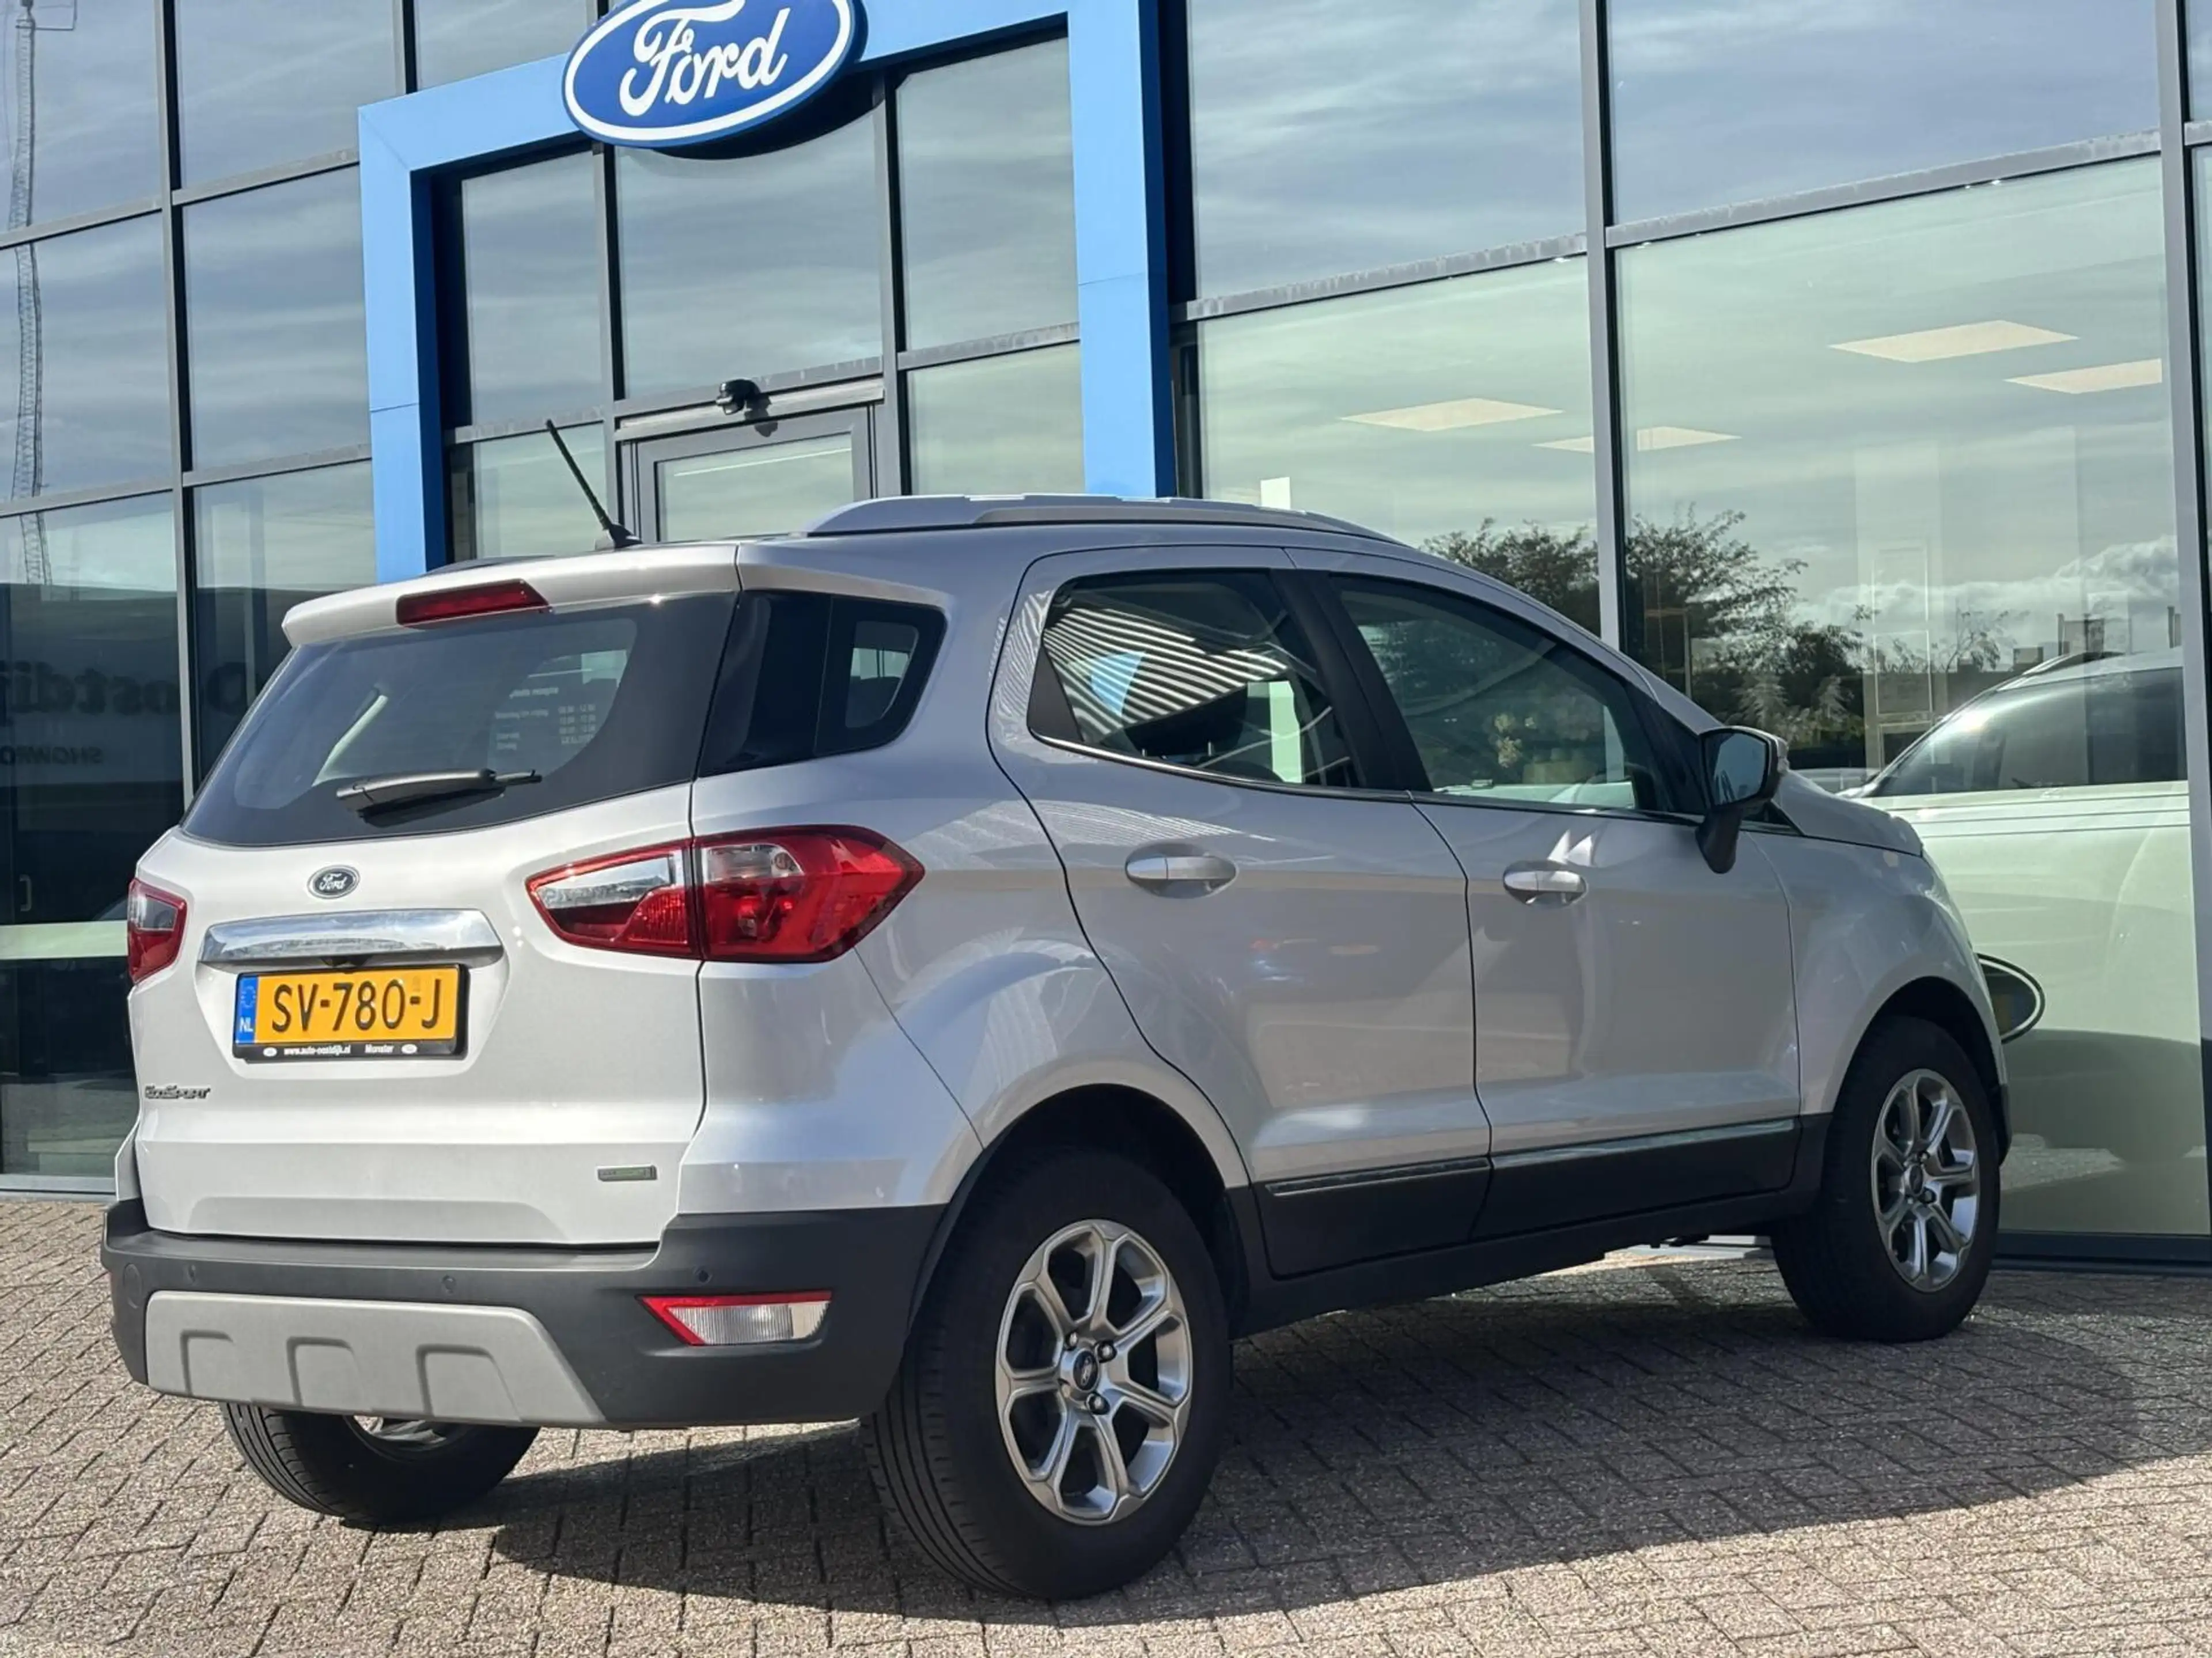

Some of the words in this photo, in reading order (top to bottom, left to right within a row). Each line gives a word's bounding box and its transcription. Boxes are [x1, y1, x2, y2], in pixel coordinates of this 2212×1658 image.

[619, 0, 790, 117] Ford
[319, 872, 347, 891] Ford
[271, 978, 442, 1033] SV-780-J
[239, 1018, 253, 1033] NL
